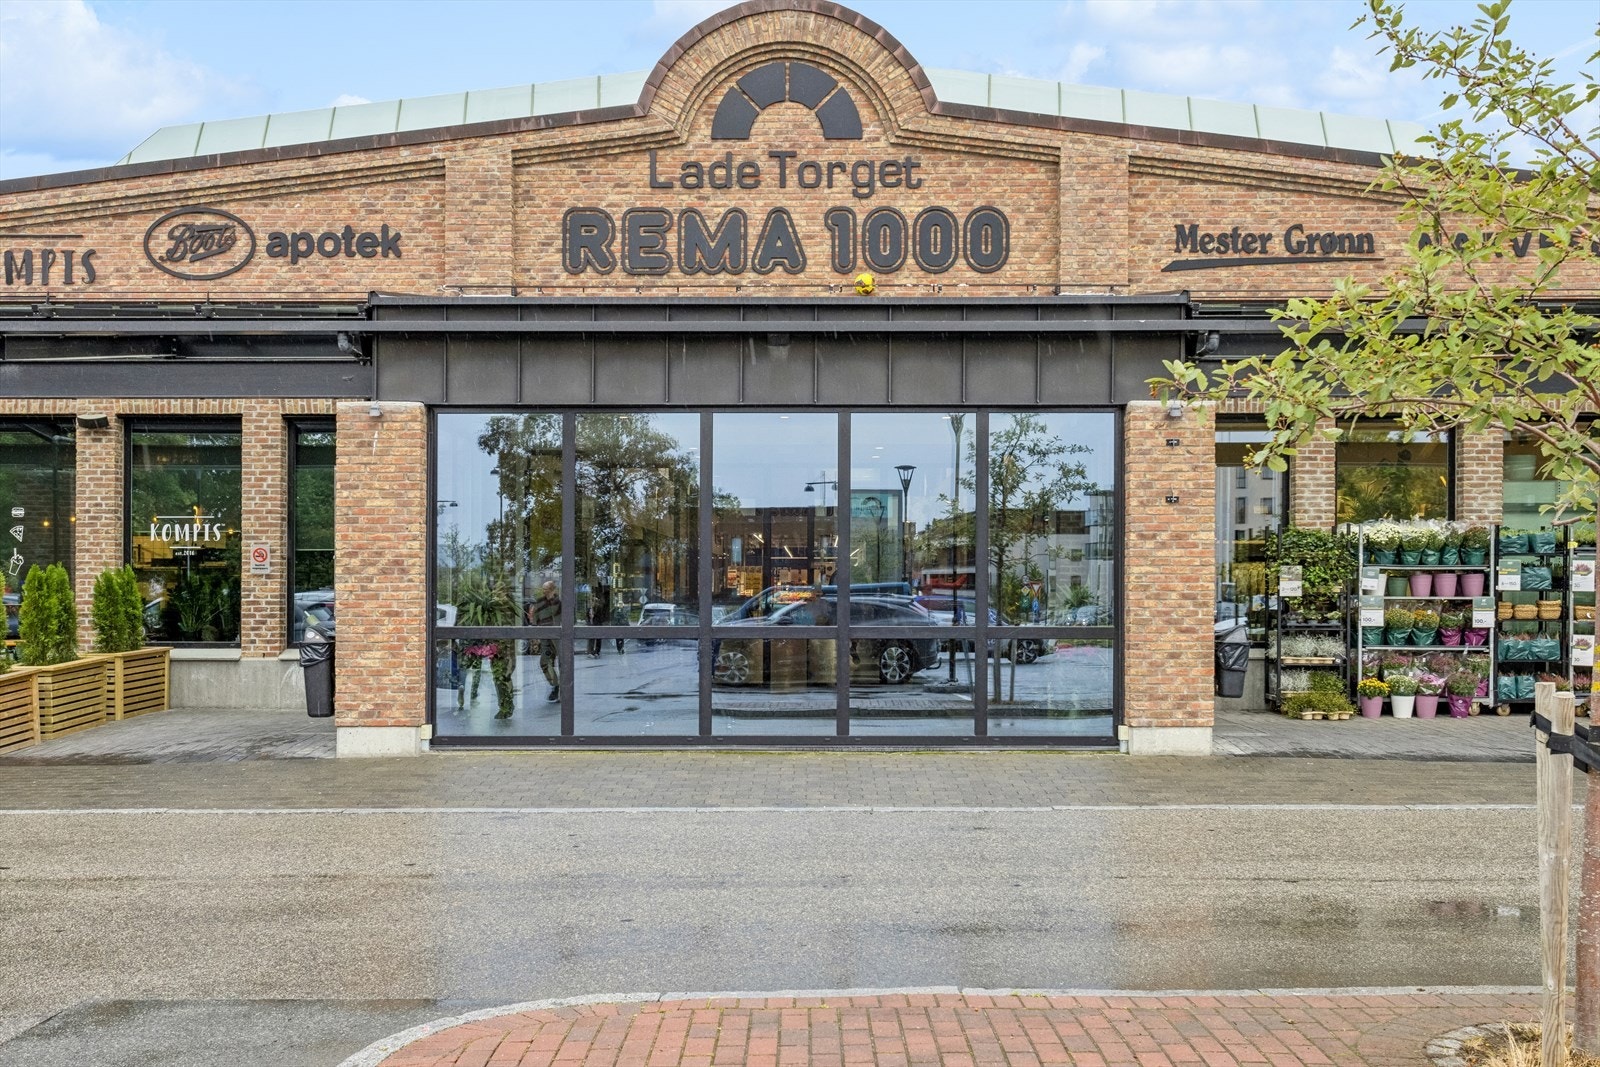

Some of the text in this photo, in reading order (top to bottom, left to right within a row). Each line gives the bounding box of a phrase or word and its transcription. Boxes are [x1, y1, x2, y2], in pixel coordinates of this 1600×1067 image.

[649, 149, 923, 199] Lade Torget
[159, 223, 402, 265] Boots apotek
[562, 205, 1010, 275] REMA 1000
[1174, 223, 1376, 254] Mester Grønn
